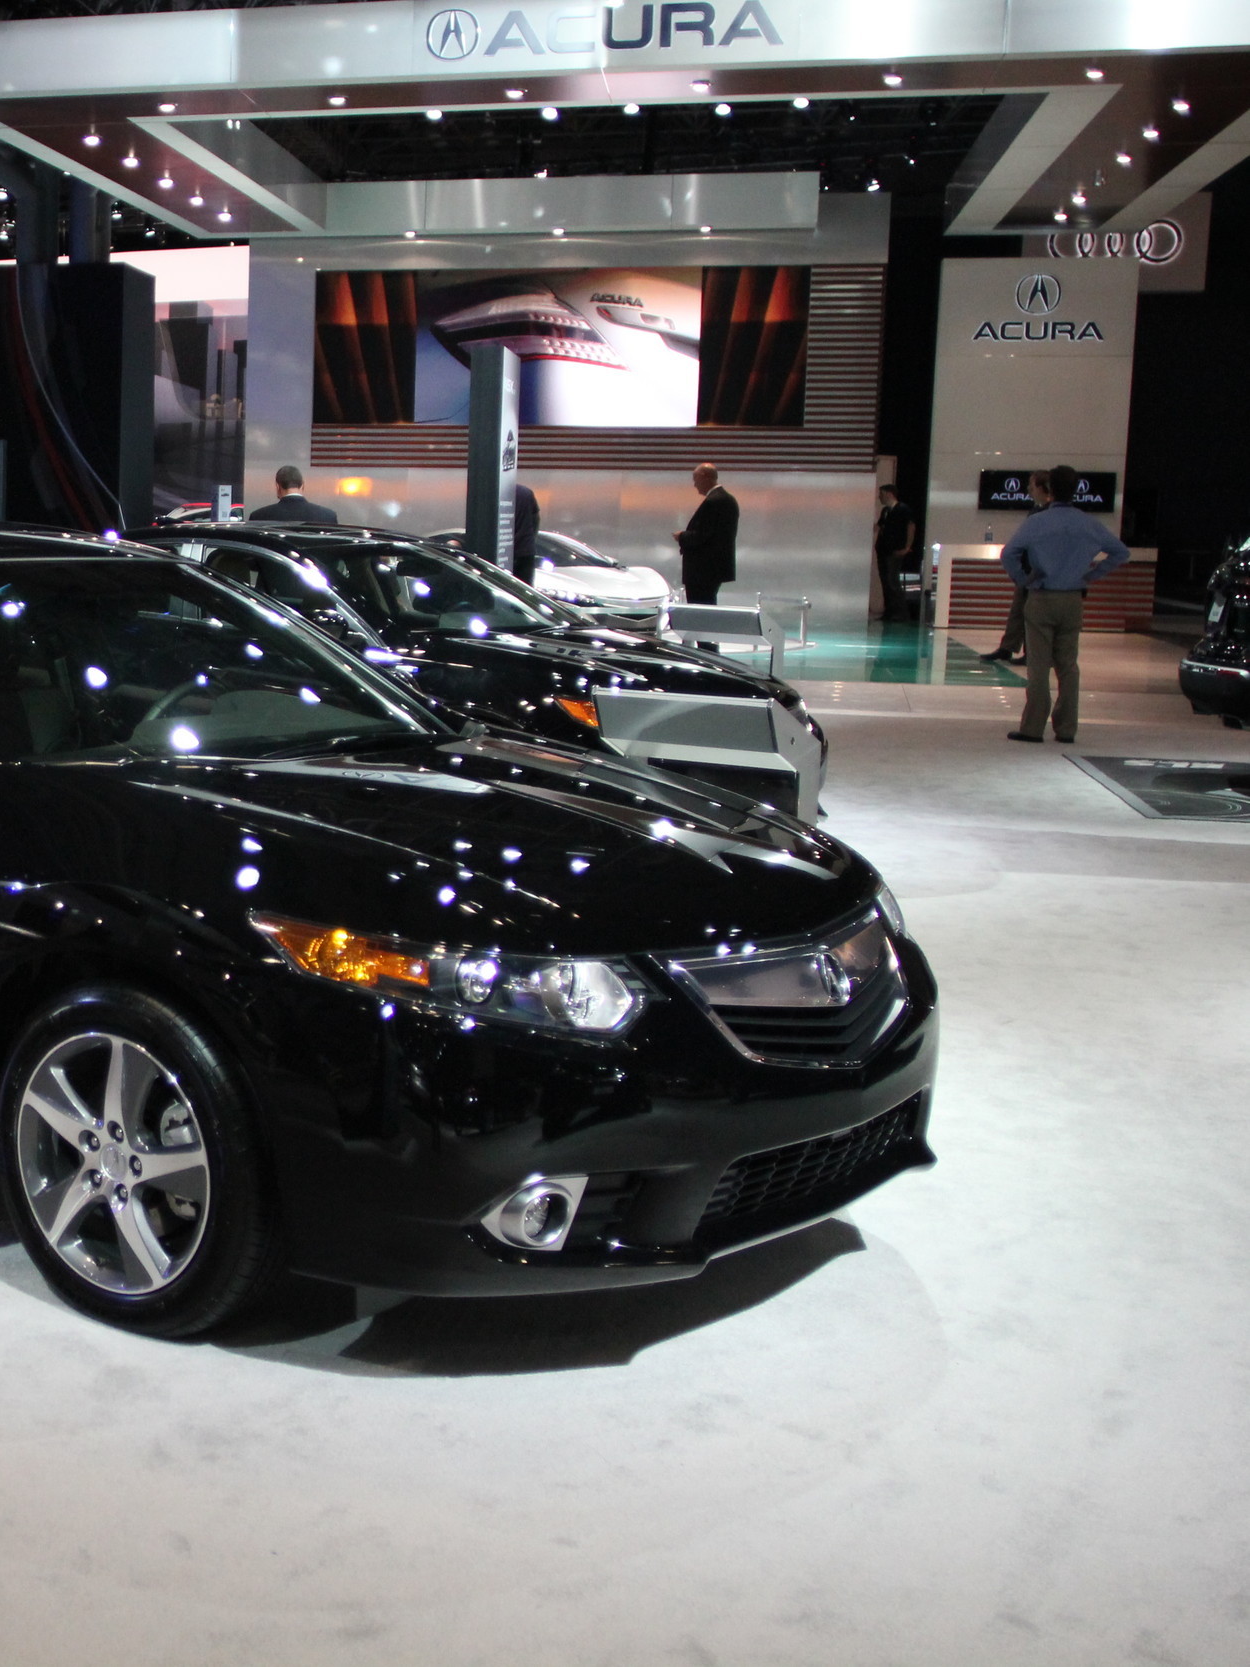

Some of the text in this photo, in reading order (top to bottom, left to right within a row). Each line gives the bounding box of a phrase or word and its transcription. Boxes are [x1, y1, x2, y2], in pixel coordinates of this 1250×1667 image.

[483, 0, 784, 57] ACURA
[590, 292, 644, 308] ACURA
[972, 321, 1104, 341] ACURA
[990, 492, 1034, 501] ACURA
